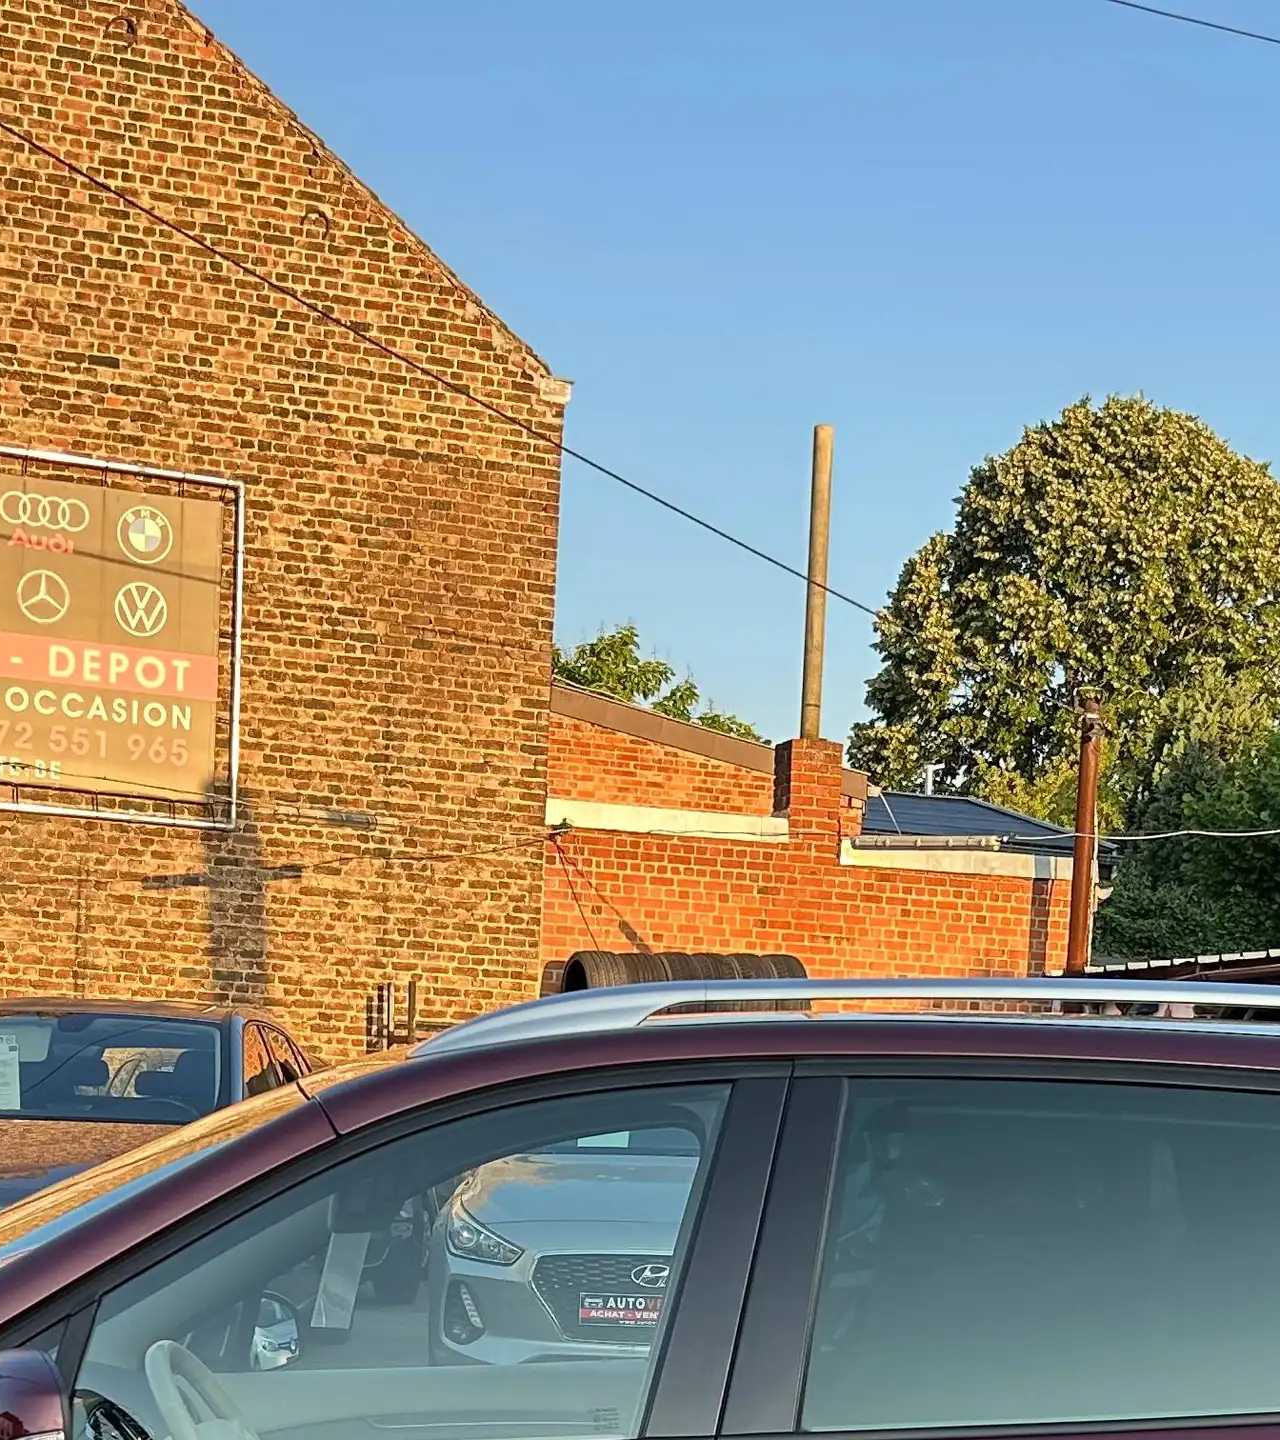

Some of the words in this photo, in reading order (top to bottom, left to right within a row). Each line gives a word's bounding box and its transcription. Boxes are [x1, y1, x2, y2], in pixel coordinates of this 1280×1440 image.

[6, 527, 75, 555] Audi
[48, 644, 191, 693] DEPOT
[48, 724, 108, 759] 551
[126, 733, 190, 767] 965
[589, 1310, 625, 1318] ACHAT
